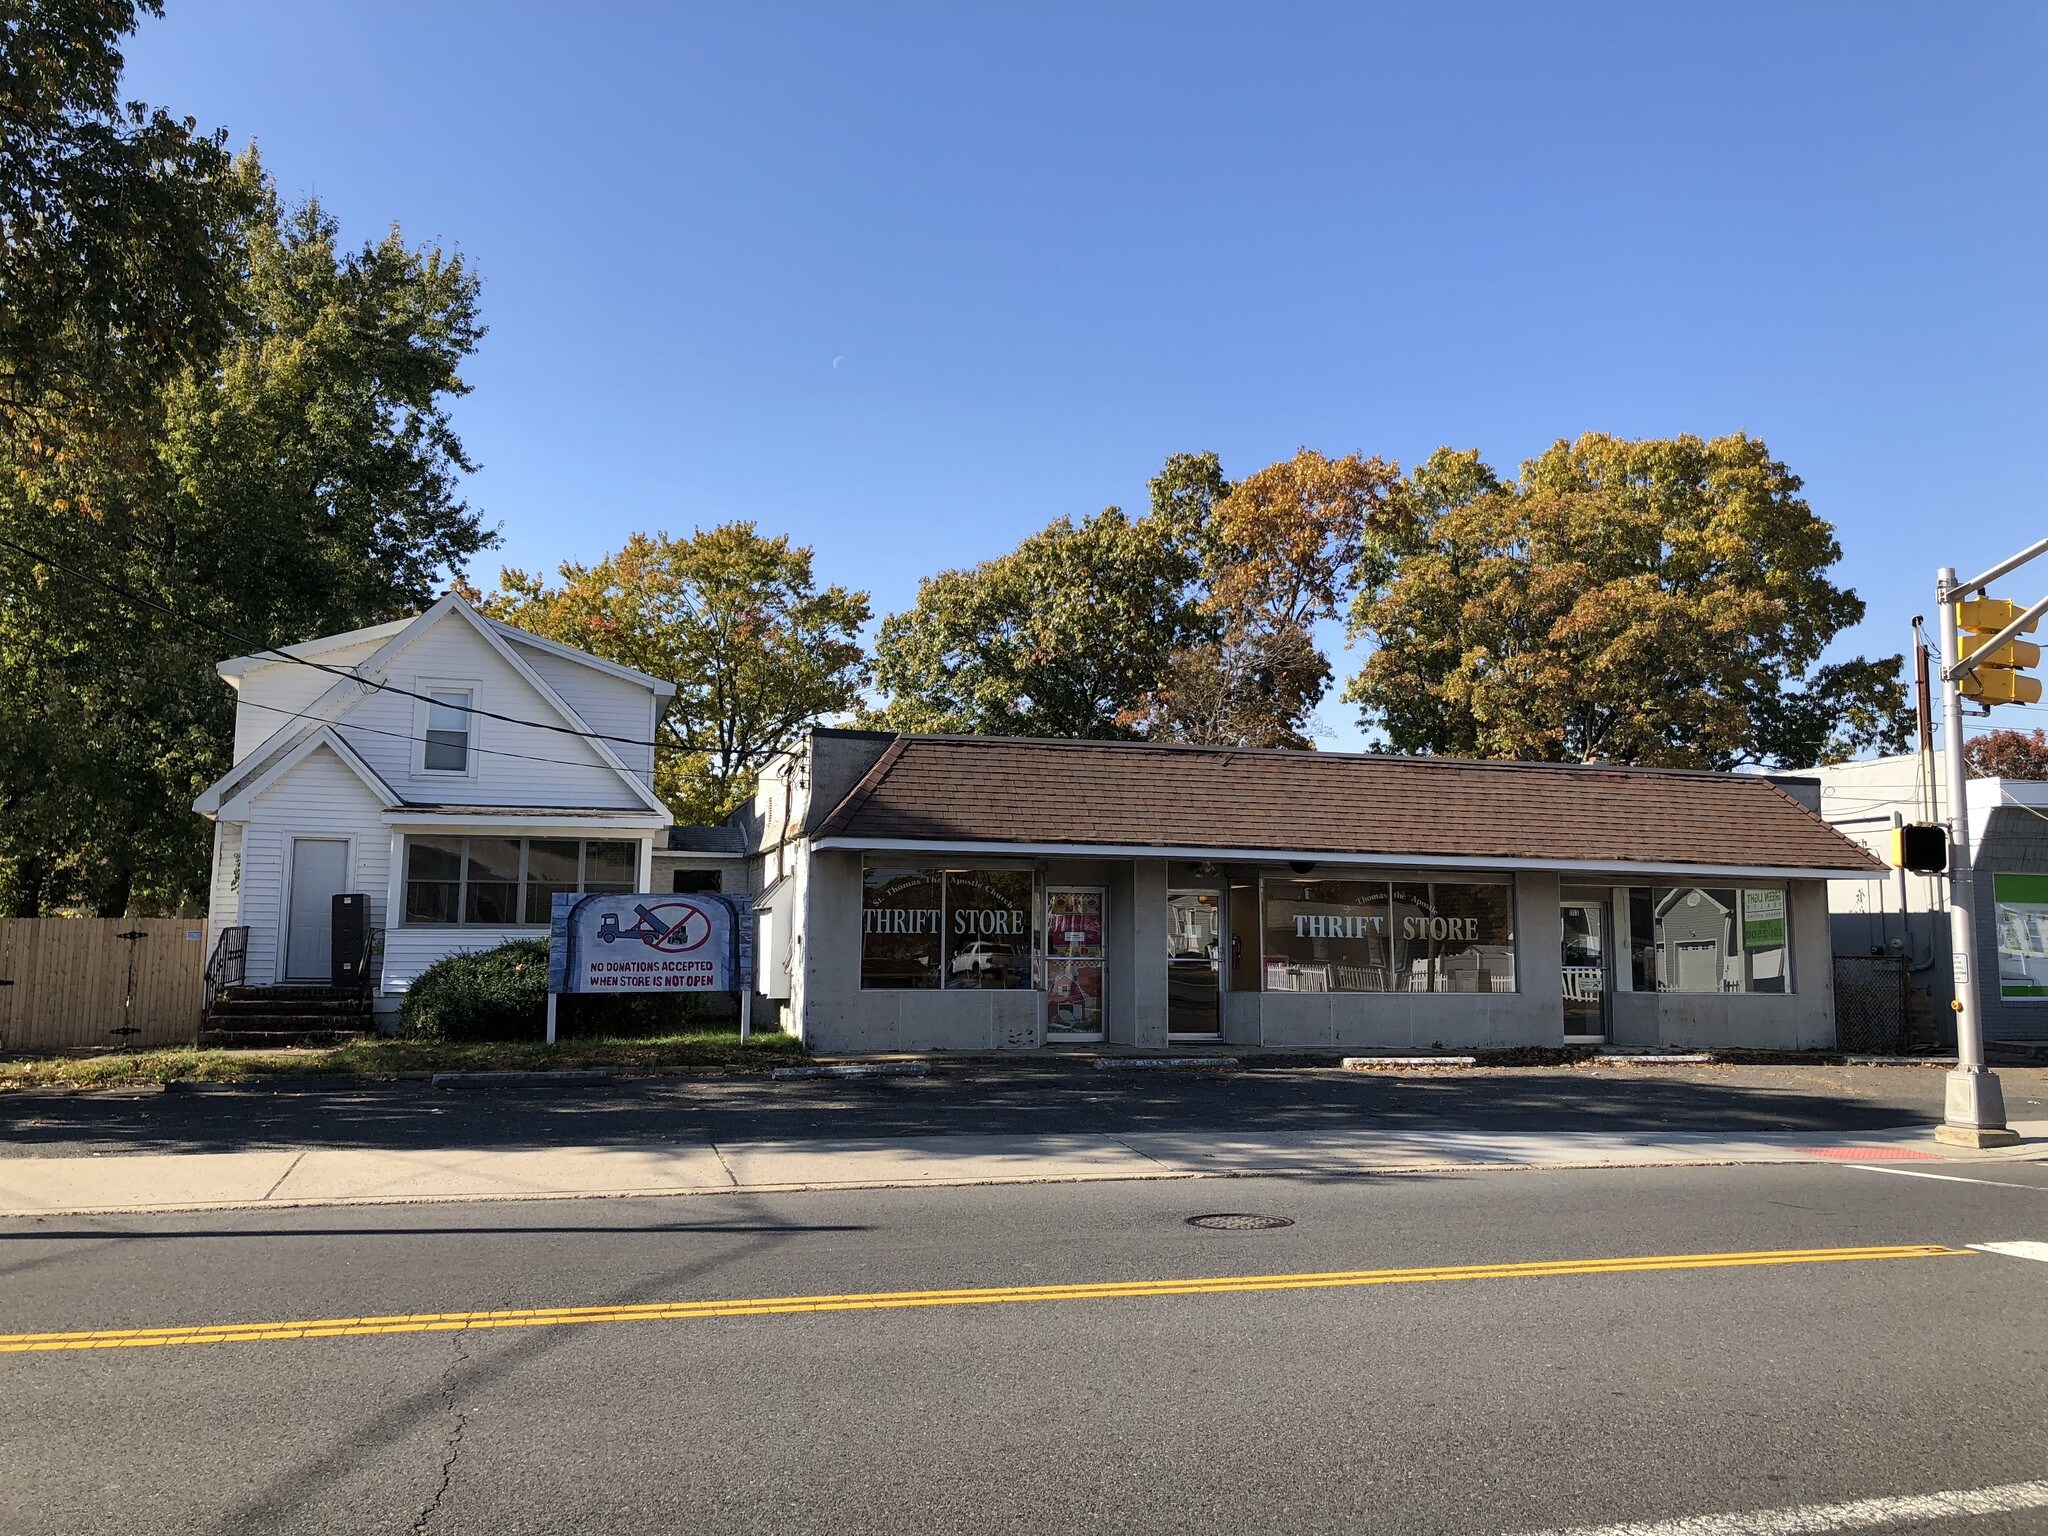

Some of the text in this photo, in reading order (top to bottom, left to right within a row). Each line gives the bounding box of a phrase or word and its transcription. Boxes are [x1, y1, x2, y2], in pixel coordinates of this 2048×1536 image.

[872, 876, 1014, 909] St. Thomas The Apostle Church
[1355, 892, 1388, 905] Thomas
[1410, 895, 1439, 916] Apostle
[862, 908, 1024, 935] THRIFT STORE
[1292, 914, 1479, 941] THRIFT STORE
[590, 961, 714, 972] NO DONATIONS ACCEPTED
[590, 974, 714, 987] WHEN STORE IS NOT OPEN
